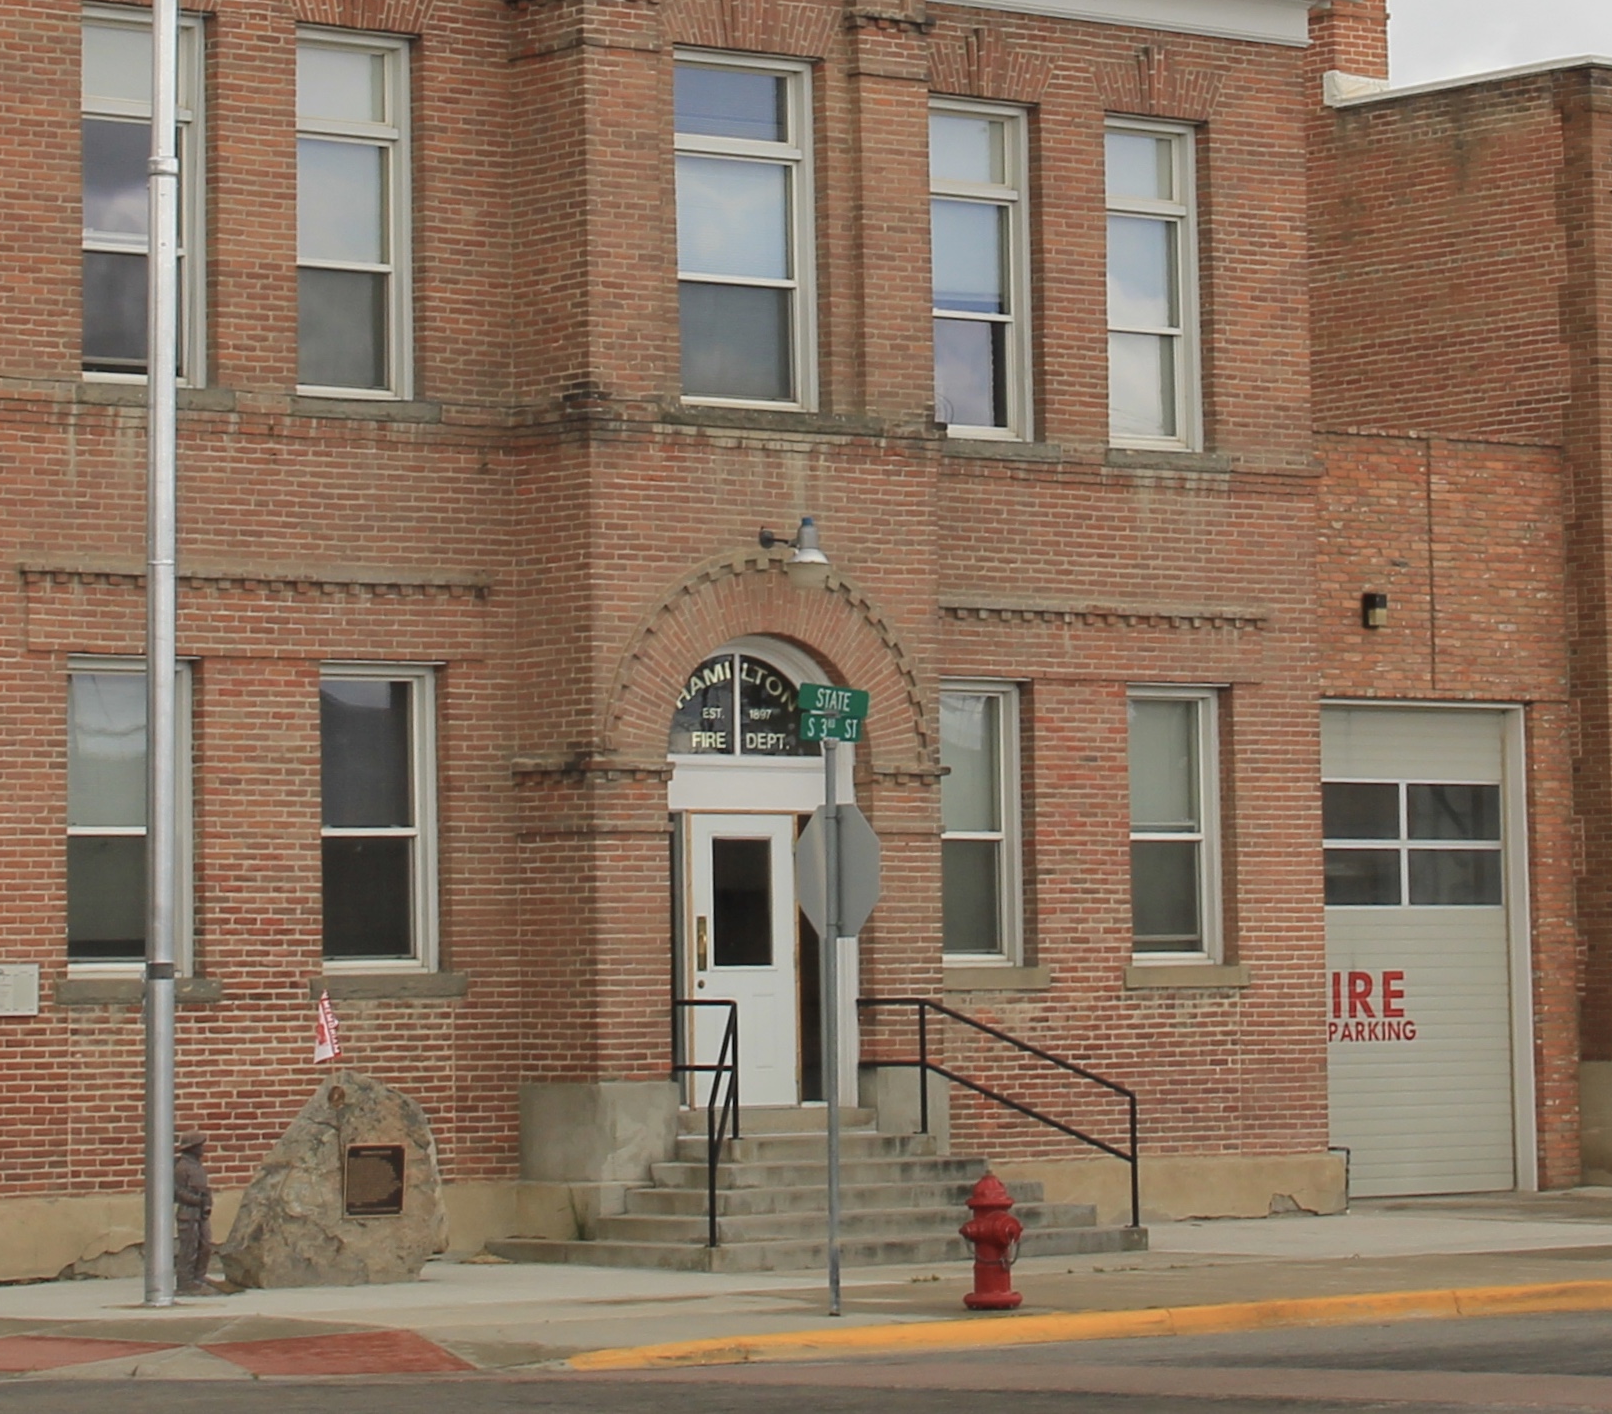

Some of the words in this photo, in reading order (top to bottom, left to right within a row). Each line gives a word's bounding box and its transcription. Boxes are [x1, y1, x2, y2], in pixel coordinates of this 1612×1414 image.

[675, 660, 797, 712] HAMILTON
[815, 688, 852, 712] STATE
[702, 707, 725, 719] EST.
[748, 709, 772, 720] 1897
[807, 717, 815, 737] S
[844, 719, 858, 738] ST
[691, 731, 727, 748] FIRE
[745, 732, 789, 750] DEPT.
[1332, 971, 1405, 1018] IRE
[1328, 1021, 1416, 1042] PARKING
